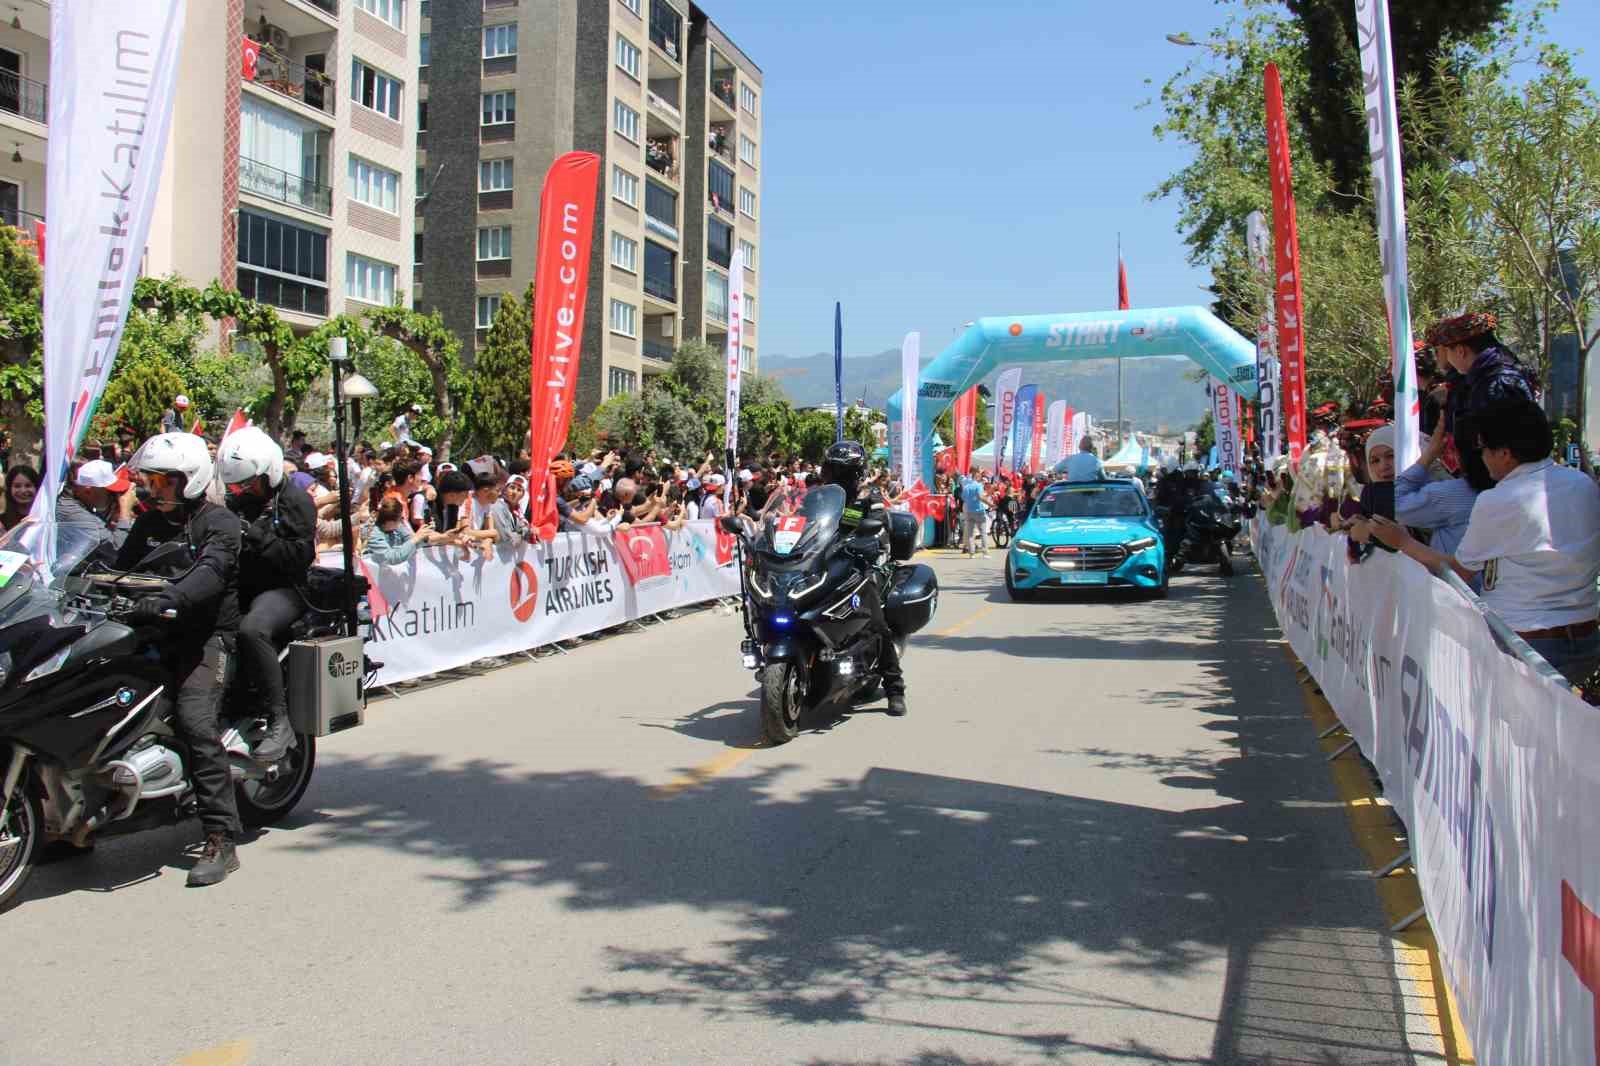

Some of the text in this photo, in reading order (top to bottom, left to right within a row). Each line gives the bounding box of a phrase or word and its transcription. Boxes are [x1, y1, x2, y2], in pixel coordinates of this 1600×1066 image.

[784, 517, 800, 531] F
[545, 550, 609, 585] TURKISH
[545, 578, 614, 616] AIRLINES
